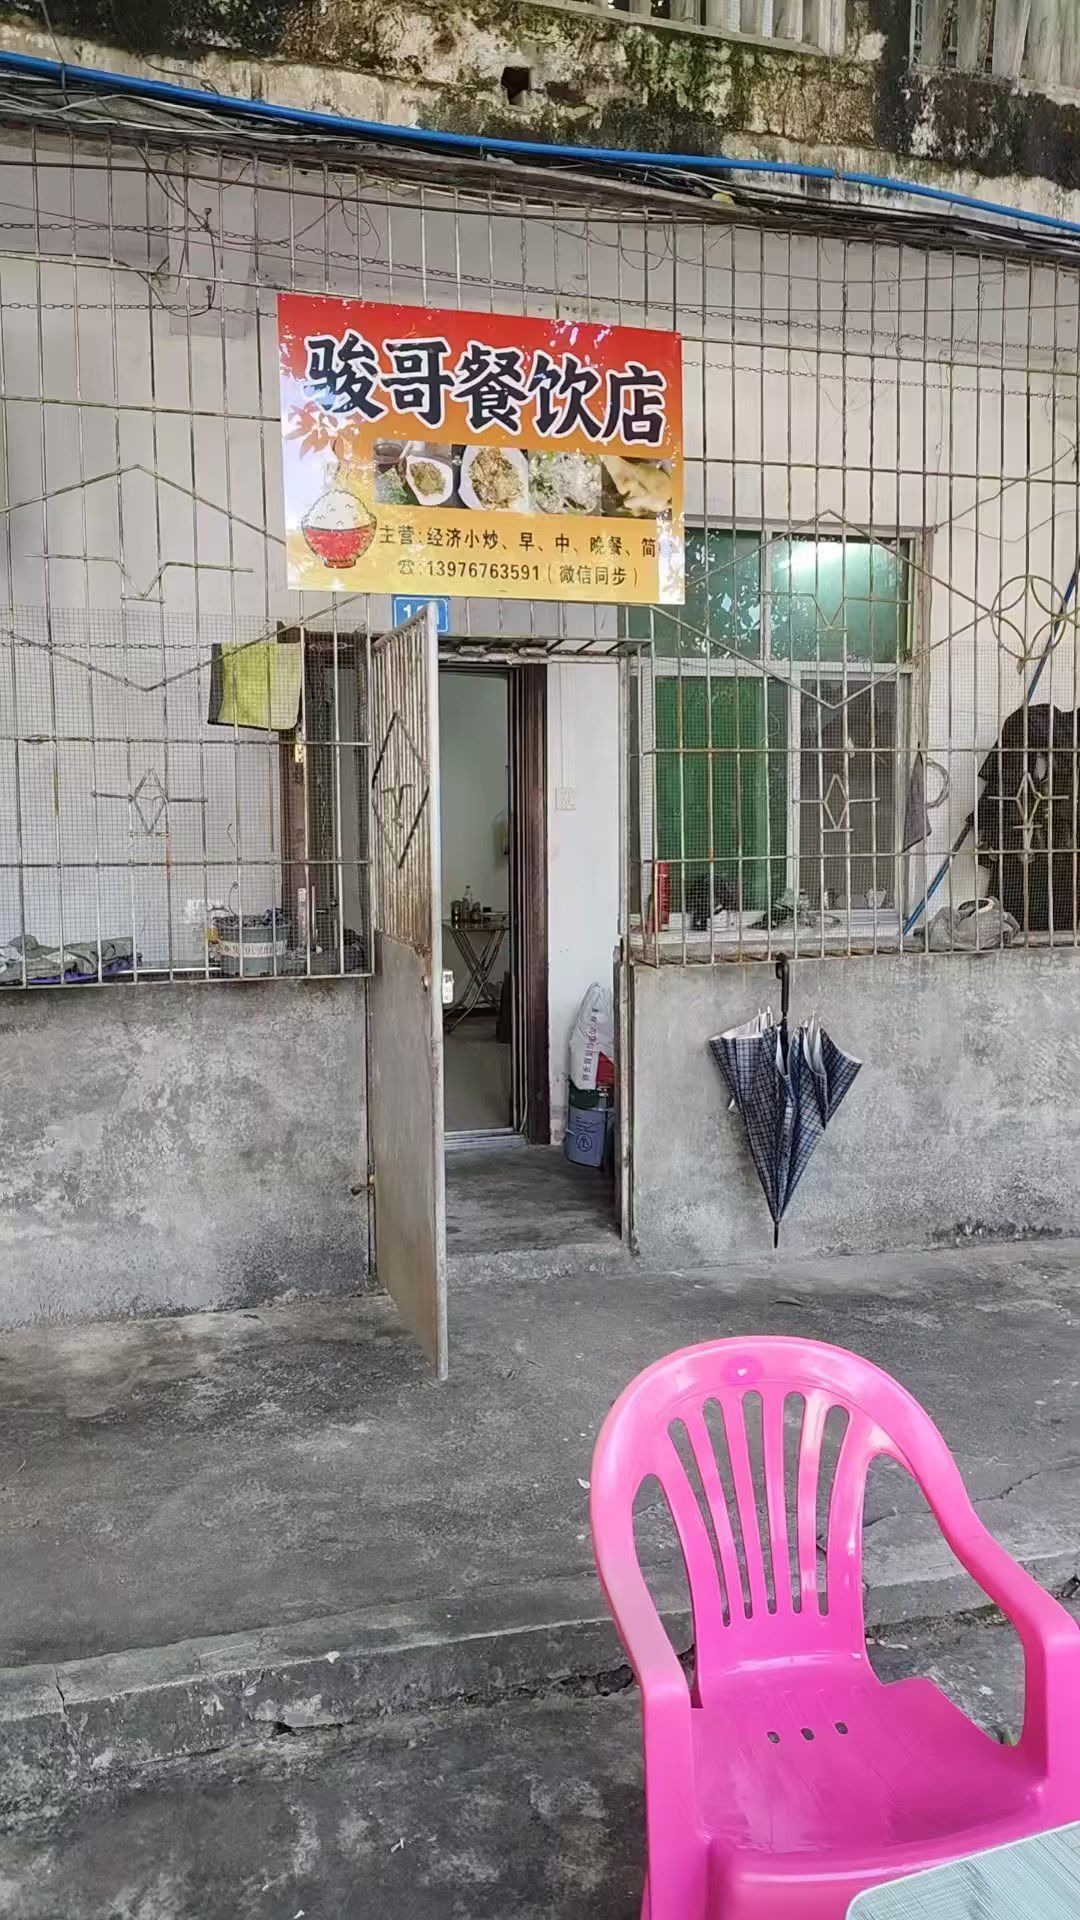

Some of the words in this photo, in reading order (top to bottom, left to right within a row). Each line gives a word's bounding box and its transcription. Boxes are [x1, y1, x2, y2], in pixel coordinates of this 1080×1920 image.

[303, 332, 666, 445] 骏哥餐饮店
[379, 524, 671, 558] 主营：经济小炒、早、中、晚餐、简
